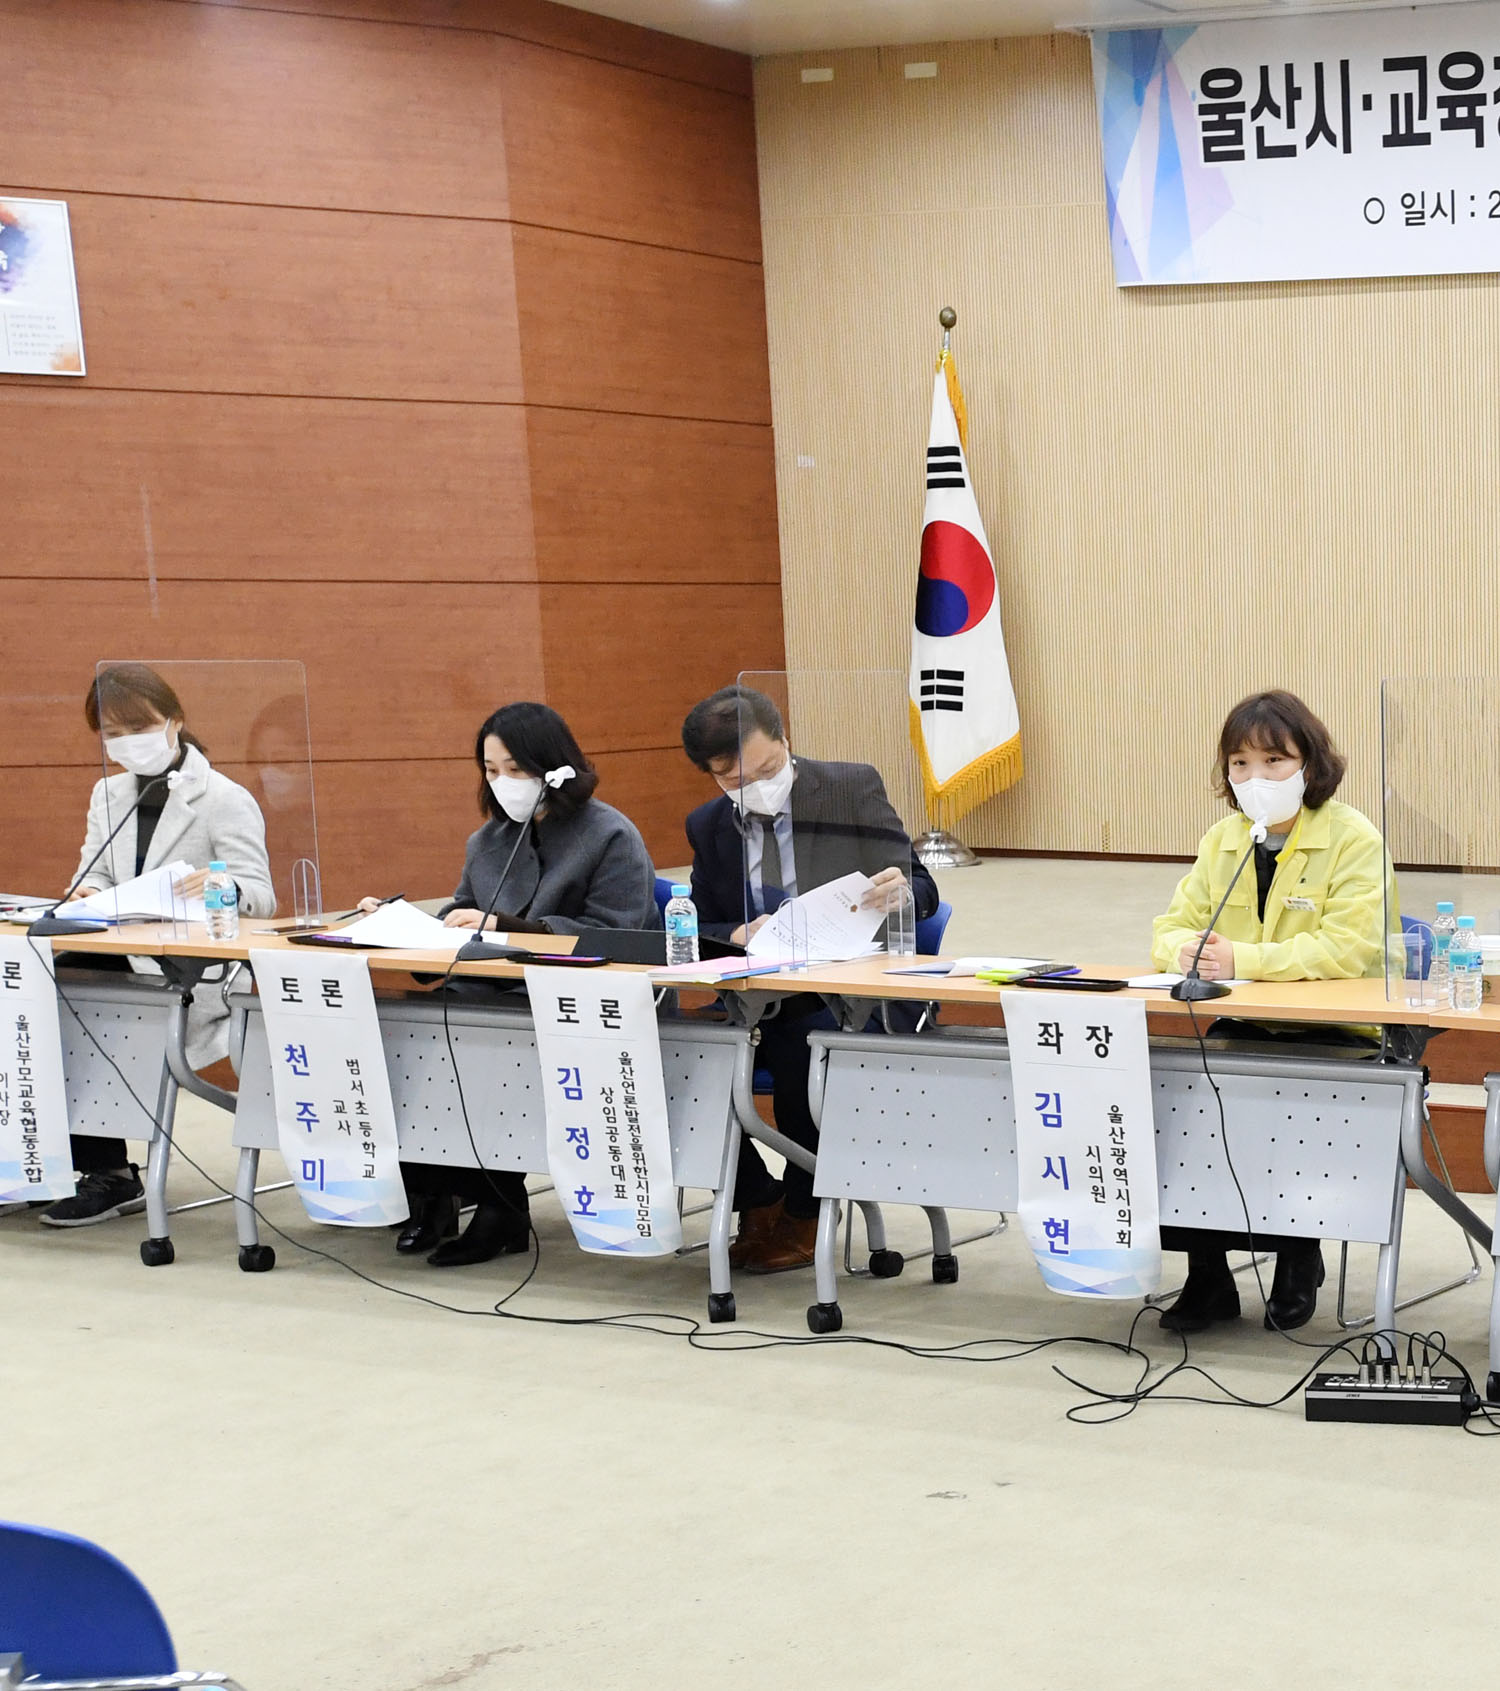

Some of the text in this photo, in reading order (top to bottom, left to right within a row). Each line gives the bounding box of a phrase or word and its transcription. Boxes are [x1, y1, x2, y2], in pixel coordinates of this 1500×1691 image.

[1400, 189, 1456, 227] 일시
[15, 1014, 44, 1184] 울산부모교육협동조합
[332, 1099, 352, 1137] 교사
[344, 1058, 377, 1179] 범서초등학교
[600, 1086, 629, 1200] 상임공동대표
[1085, 1145, 1107, 1204] 시의원
[1103, 1104, 1132, 1249] 울산광역시의회
